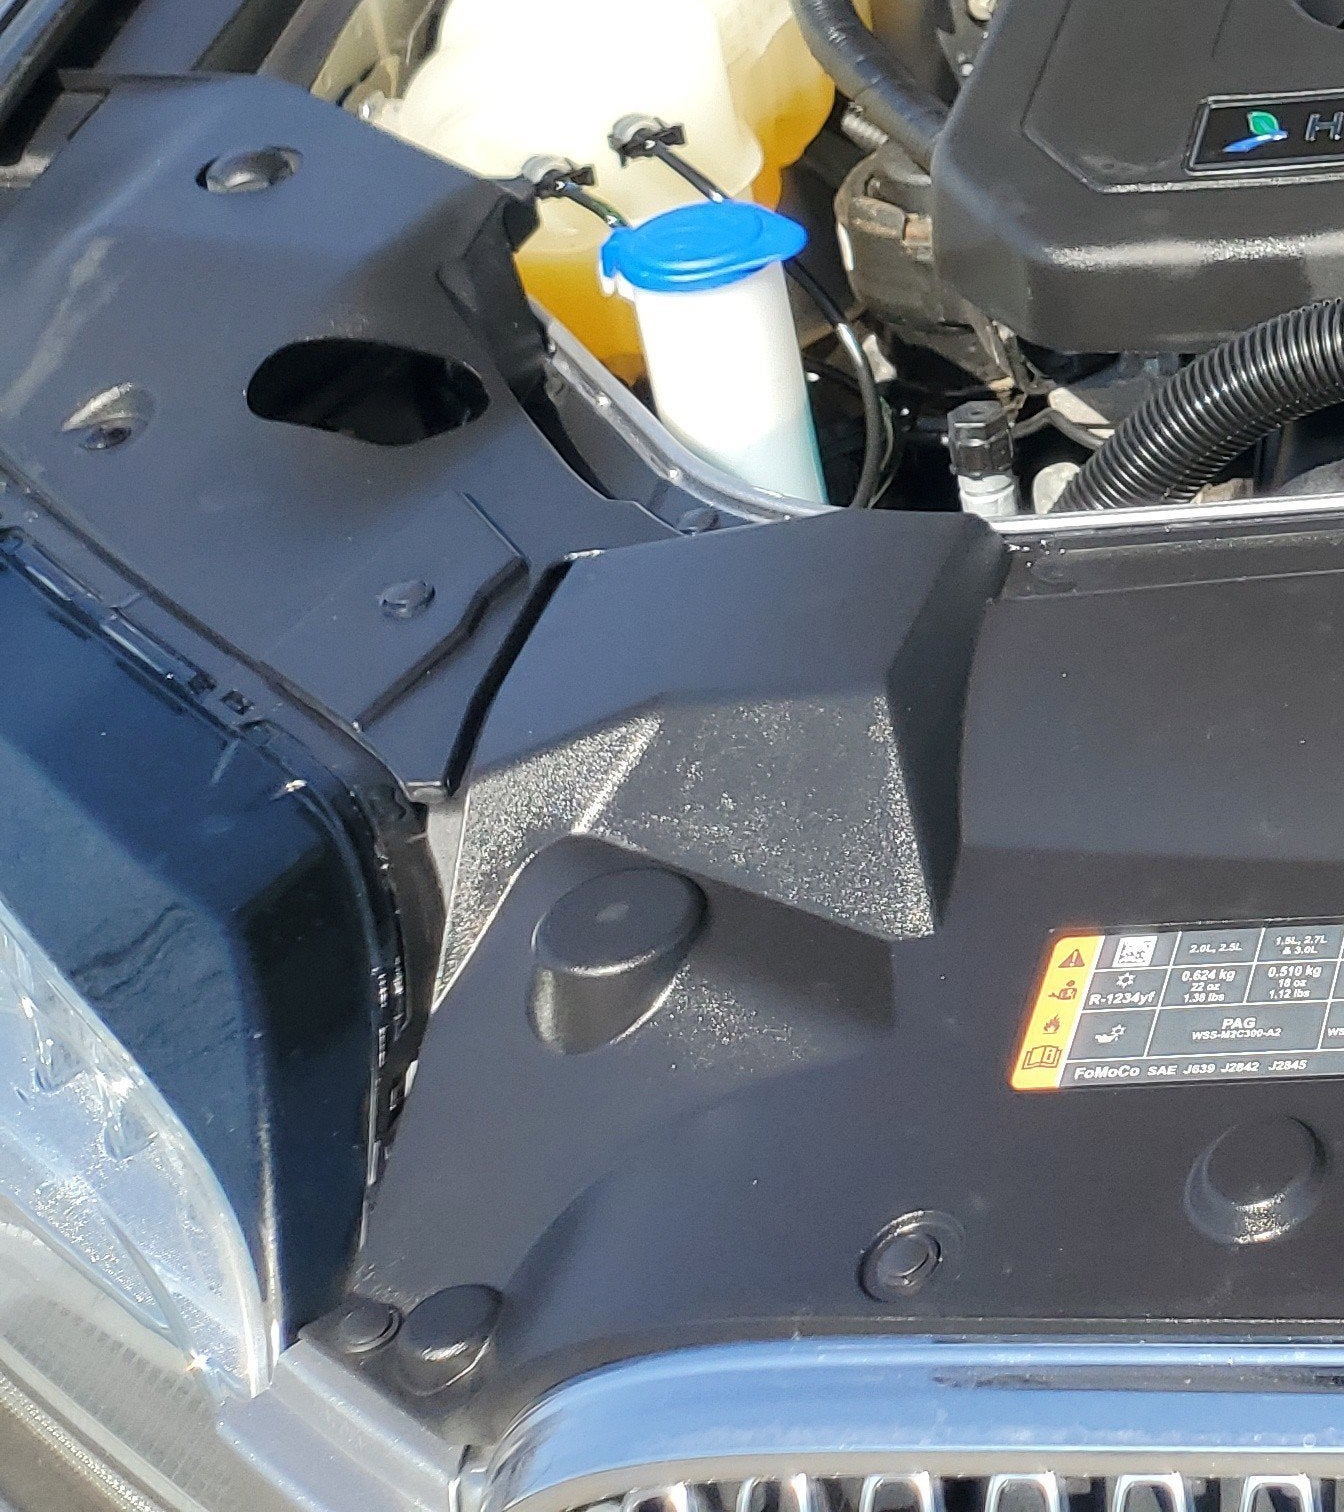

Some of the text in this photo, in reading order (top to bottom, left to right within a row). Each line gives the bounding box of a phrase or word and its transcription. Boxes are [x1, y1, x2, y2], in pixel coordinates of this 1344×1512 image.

[1181, 968, 1236, 982] 0.624 kg
[1268, 965, 1322, 978] 0.510 kg
[1190, 983, 1204, 991] 22
[1293, 979, 1307, 987] oz
[1088, 991, 1156, 1006] R-1234yf
[1207, 993, 1225, 1002] lbs
[1269, 989, 1311, 999] 1.12 lbs
[1221, 1017, 1257, 1029] PAG
[1074, 1065, 1141, 1080] FoMoCo
[1147, 1065, 1178, 1076] SAE
